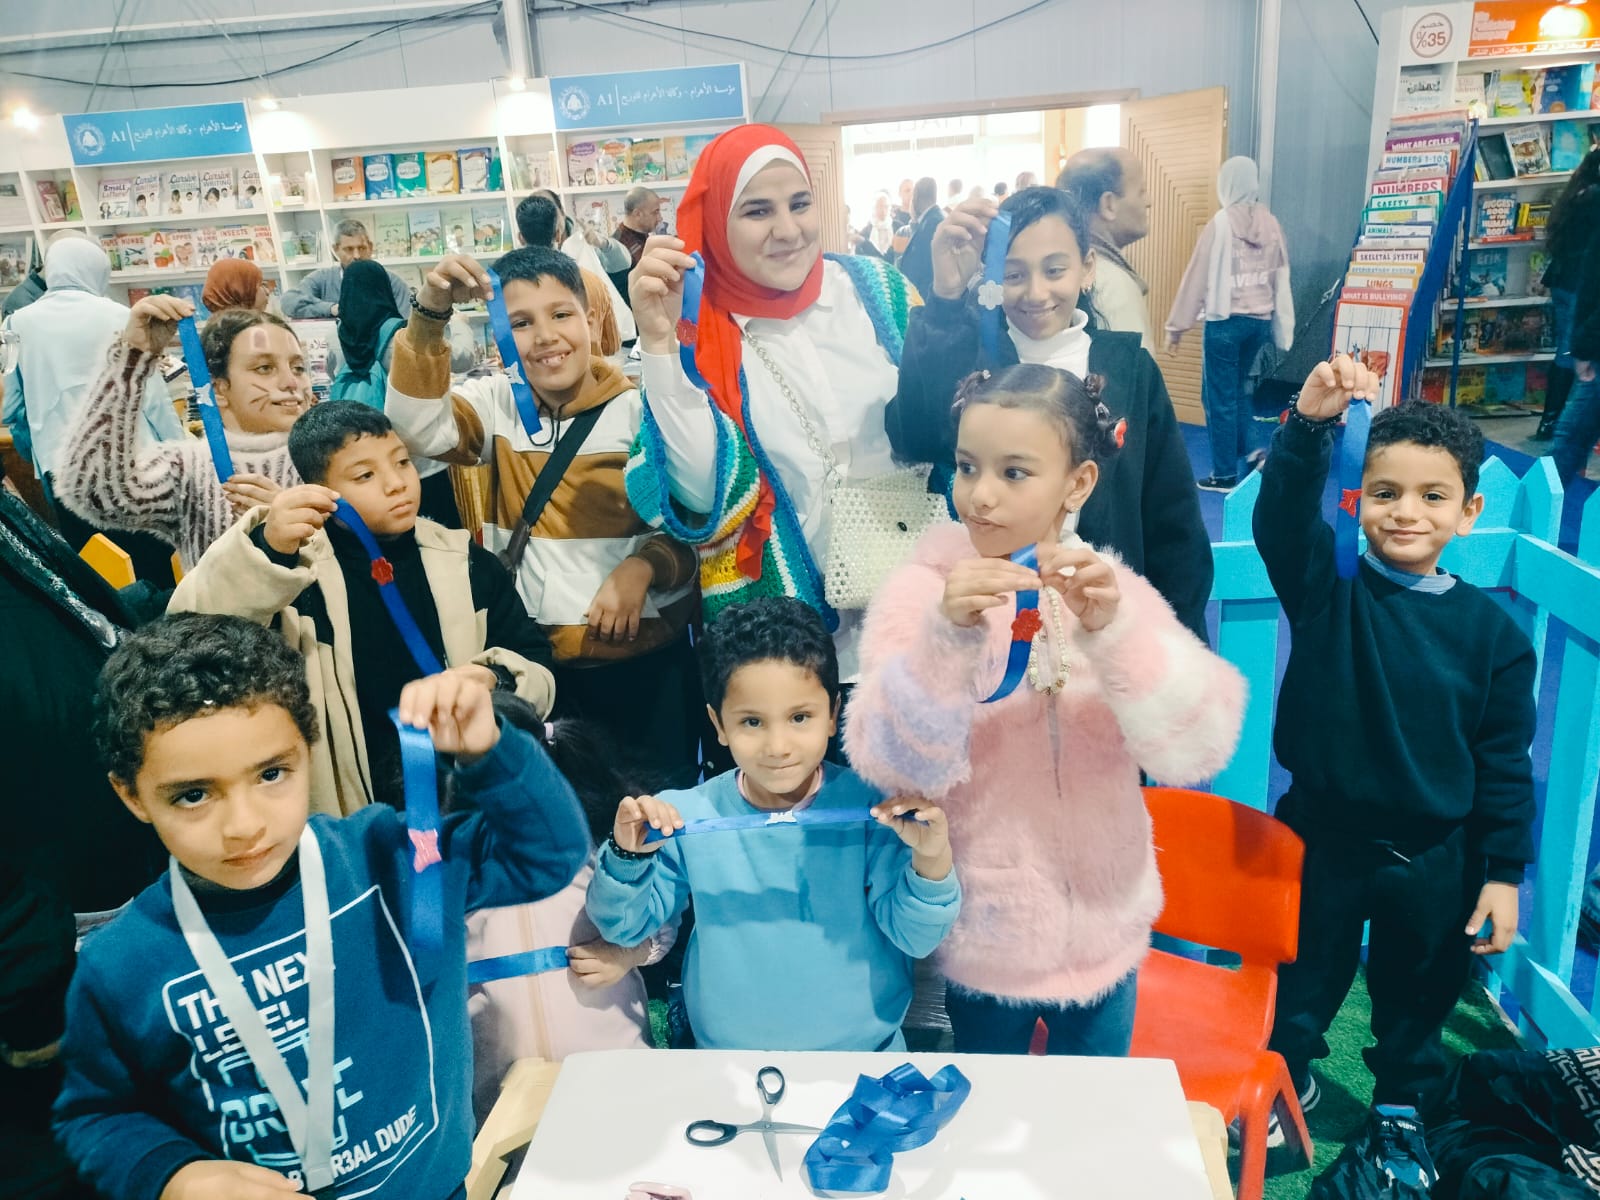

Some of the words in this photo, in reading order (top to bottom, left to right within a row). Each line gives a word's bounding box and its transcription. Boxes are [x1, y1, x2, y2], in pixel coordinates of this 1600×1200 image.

[597, 93, 613, 106] A1
[111, 130, 126, 143] A1
[1391, 142, 1412, 150] WHAT
[1413, 140, 1427, 149] ARE
[1427, 136, 1454, 146] CELLS?
[1385, 155, 1422, 164] NUMBERS
[1377, 181, 1438, 194] NUMBERS
[220, 228, 248, 237] INSECTS
[1360, 253, 1391, 261] SKELETAL
[1393, 252, 1419, 260] SYSTEM
[1366, 279, 1393, 288] LUNGS
[177, 980, 238, 1030] TH
[251, 952, 318, 1002] NEX
[194, 1000, 306, 1064] LEEL
[374, 1104, 417, 1152] DUDE
